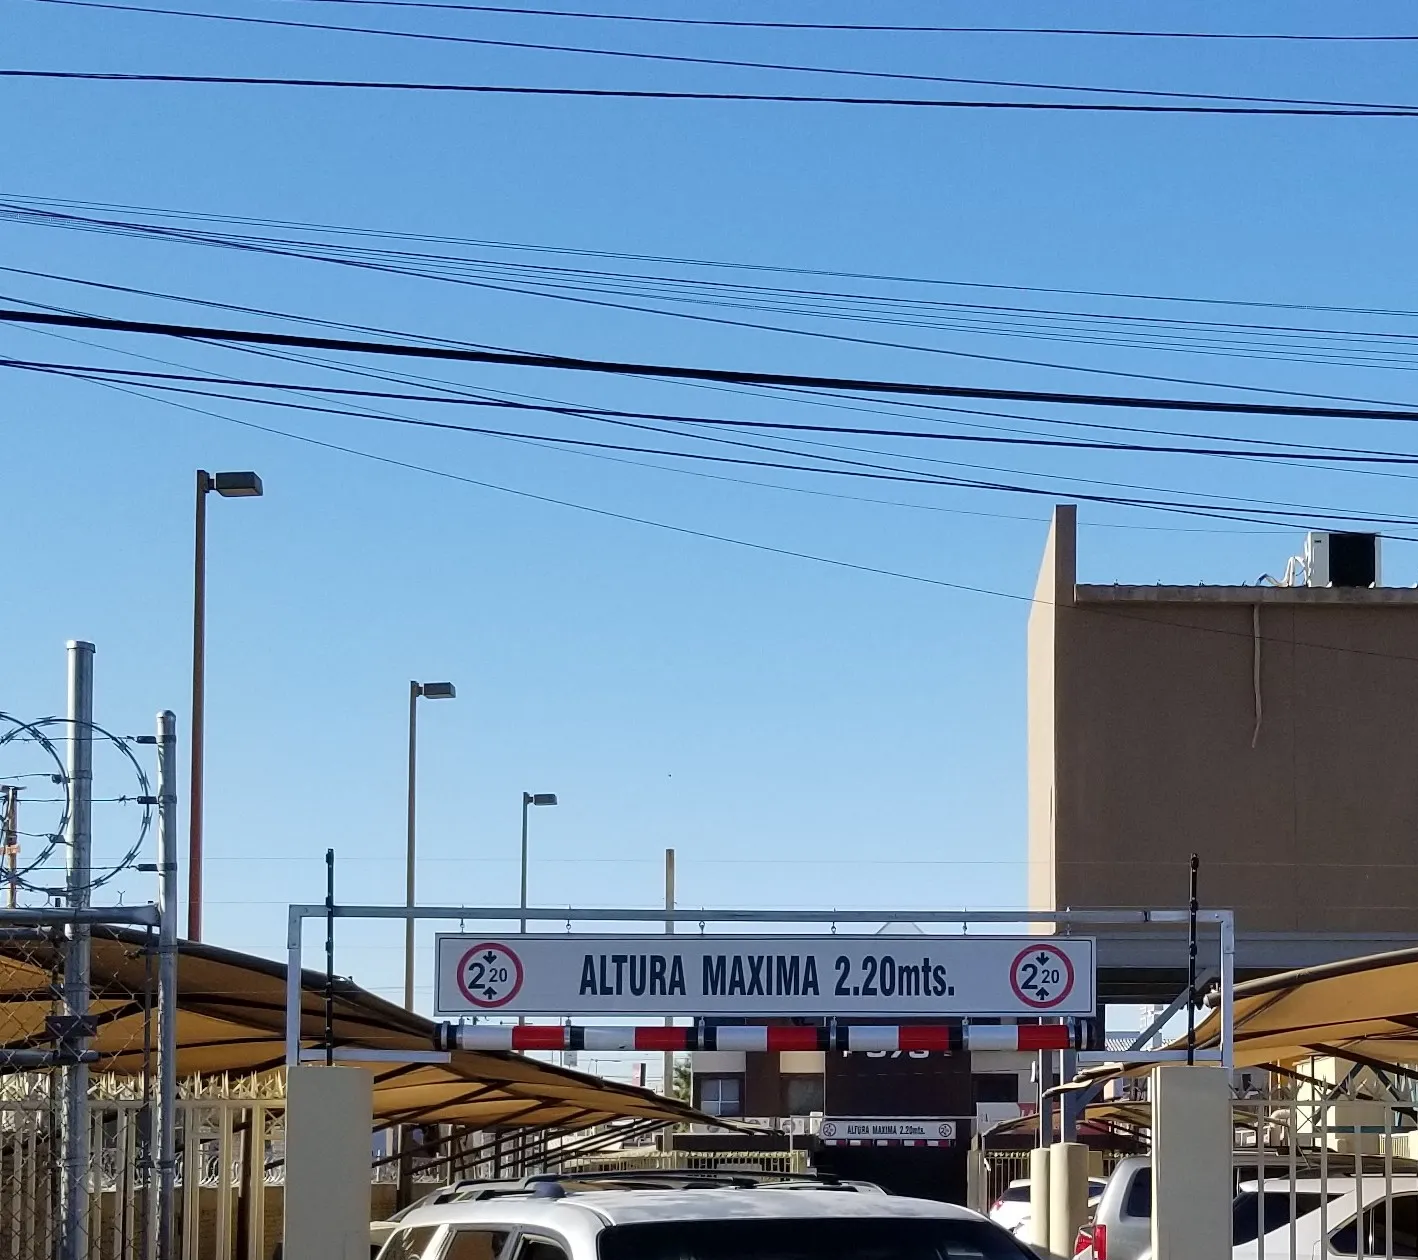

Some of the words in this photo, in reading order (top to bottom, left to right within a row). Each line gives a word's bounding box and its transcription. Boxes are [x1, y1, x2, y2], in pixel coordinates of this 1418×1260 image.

[579, 954, 687, 997] ALTURA
[702, 954, 820, 997] MAXIMA
[833, 954, 955, 997] 2.20mts.
[872, 1125, 898, 1135] MAXIMA
